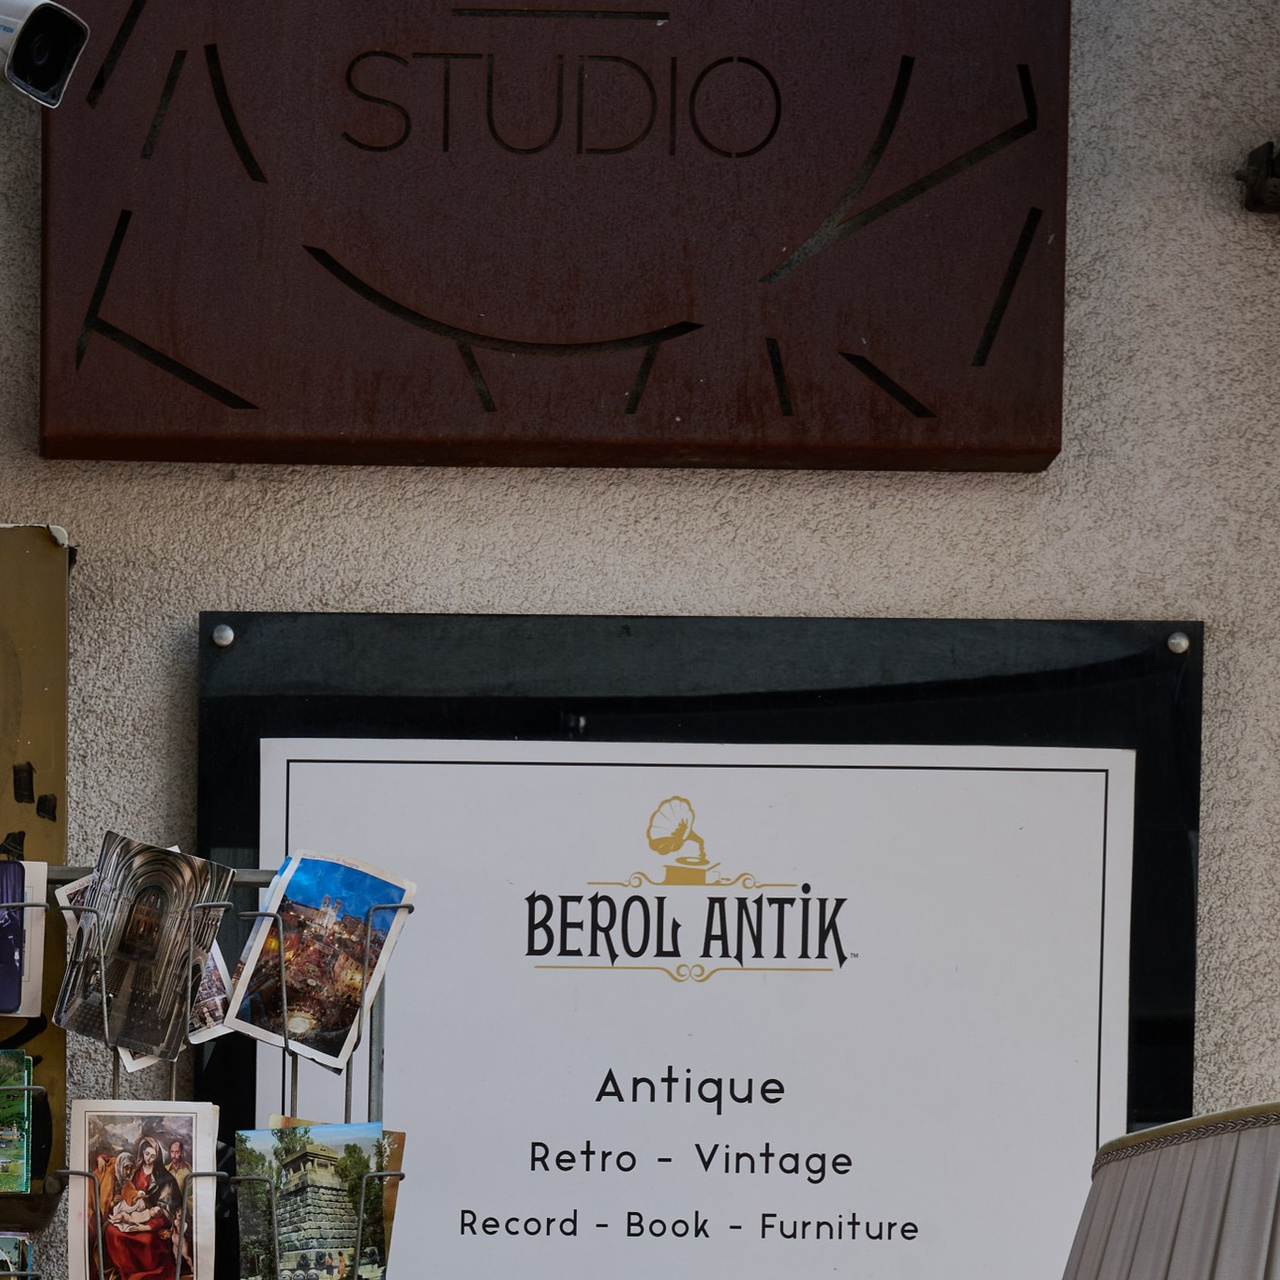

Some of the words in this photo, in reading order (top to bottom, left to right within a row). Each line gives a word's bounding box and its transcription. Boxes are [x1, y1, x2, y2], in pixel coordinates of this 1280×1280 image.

[342, 51, 781, 158] STUDIO
[525, 891, 681, 966] BEROL
[596, 1066, 784, 1115] Antique
[531, 1141, 637, 1173] Retro
[695, 1143, 853, 1185] Vintage
[460, 1208, 578, 1237] Record
[626, 1210, 710, 1238] Book
[761, 1212, 919, 1241] Furniture
